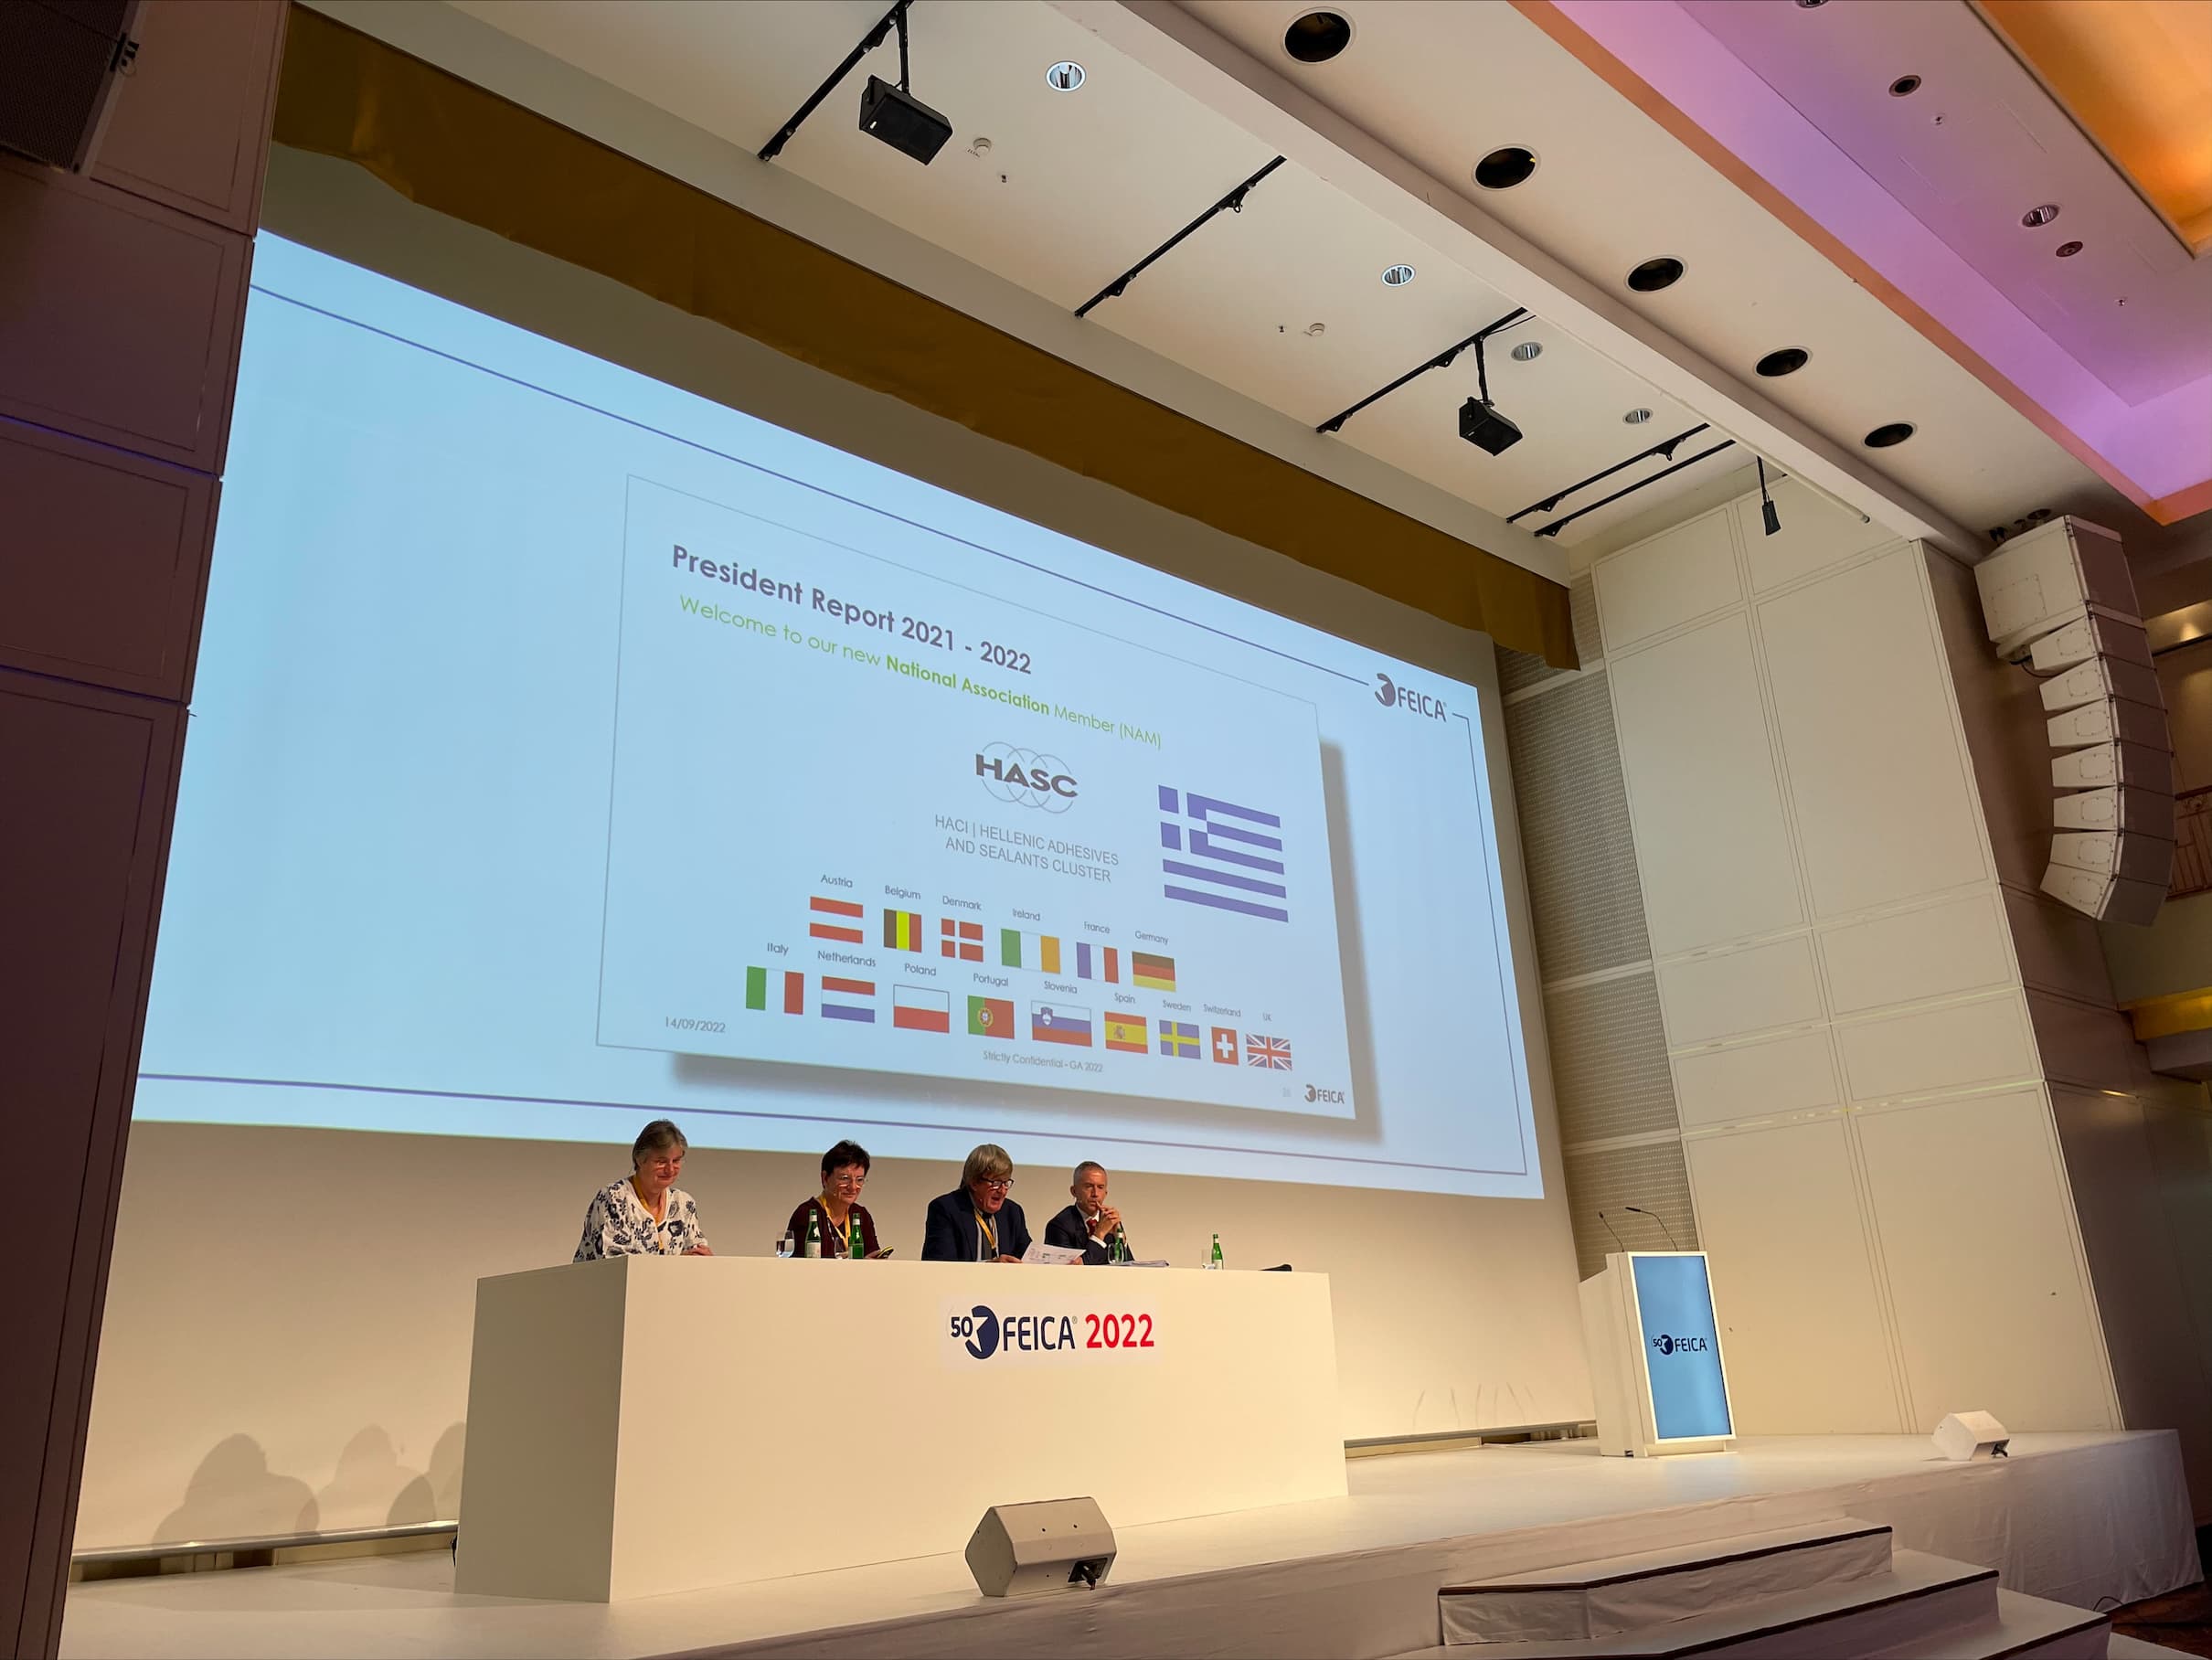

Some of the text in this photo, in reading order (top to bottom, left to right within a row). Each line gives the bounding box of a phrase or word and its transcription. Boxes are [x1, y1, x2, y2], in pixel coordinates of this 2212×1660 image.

[673, 544, 1032, 675] President Report 2021 - 2022
[680, 594, 1162, 750] Welcome to our new National Association Member (NAM)
[1398, 686, 1447, 722] FEICA
[975, 753, 1078, 798] HASC
[935, 814, 968, 834] HACI
[980, 825, 1044, 850] HELLENIC
[1048, 839, 1119, 866] ADHESIVES
[945, 836, 1111, 883] AND SEALANTS CLUSTER
[821, 875, 853, 889] Austria
[885, 885, 921, 900] Belgium
[942, 896, 982, 910] Denmark
[1012, 909, 1040, 921] Ireland
[1083, 921, 1111, 934] France
[1134, 931, 1168, 945] Germany
[817, 951, 876, 967] Netherlands
[904, 963, 936, 976] Poland
[973, 973, 1008, 987] Portugal
[1044, 981, 1078, 995] Slovenia
[1114, 993, 1135, 1005] Spain
[1163, 1000, 1191, 1012] Sweden
[1203, 1004, 1241, 1017] Switzerland
[1262, 1013, 1272, 1022] UK
[665, 1016, 727, 1033] 14/09/2022
[983, 1051, 1010, 1064] Strictly
[1013, 1054, 1063, 1068] Confidential
[951, 1314, 1154, 1351] 50 FEICA 2022
[1675, 1337, 1707, 1352] FEICA
